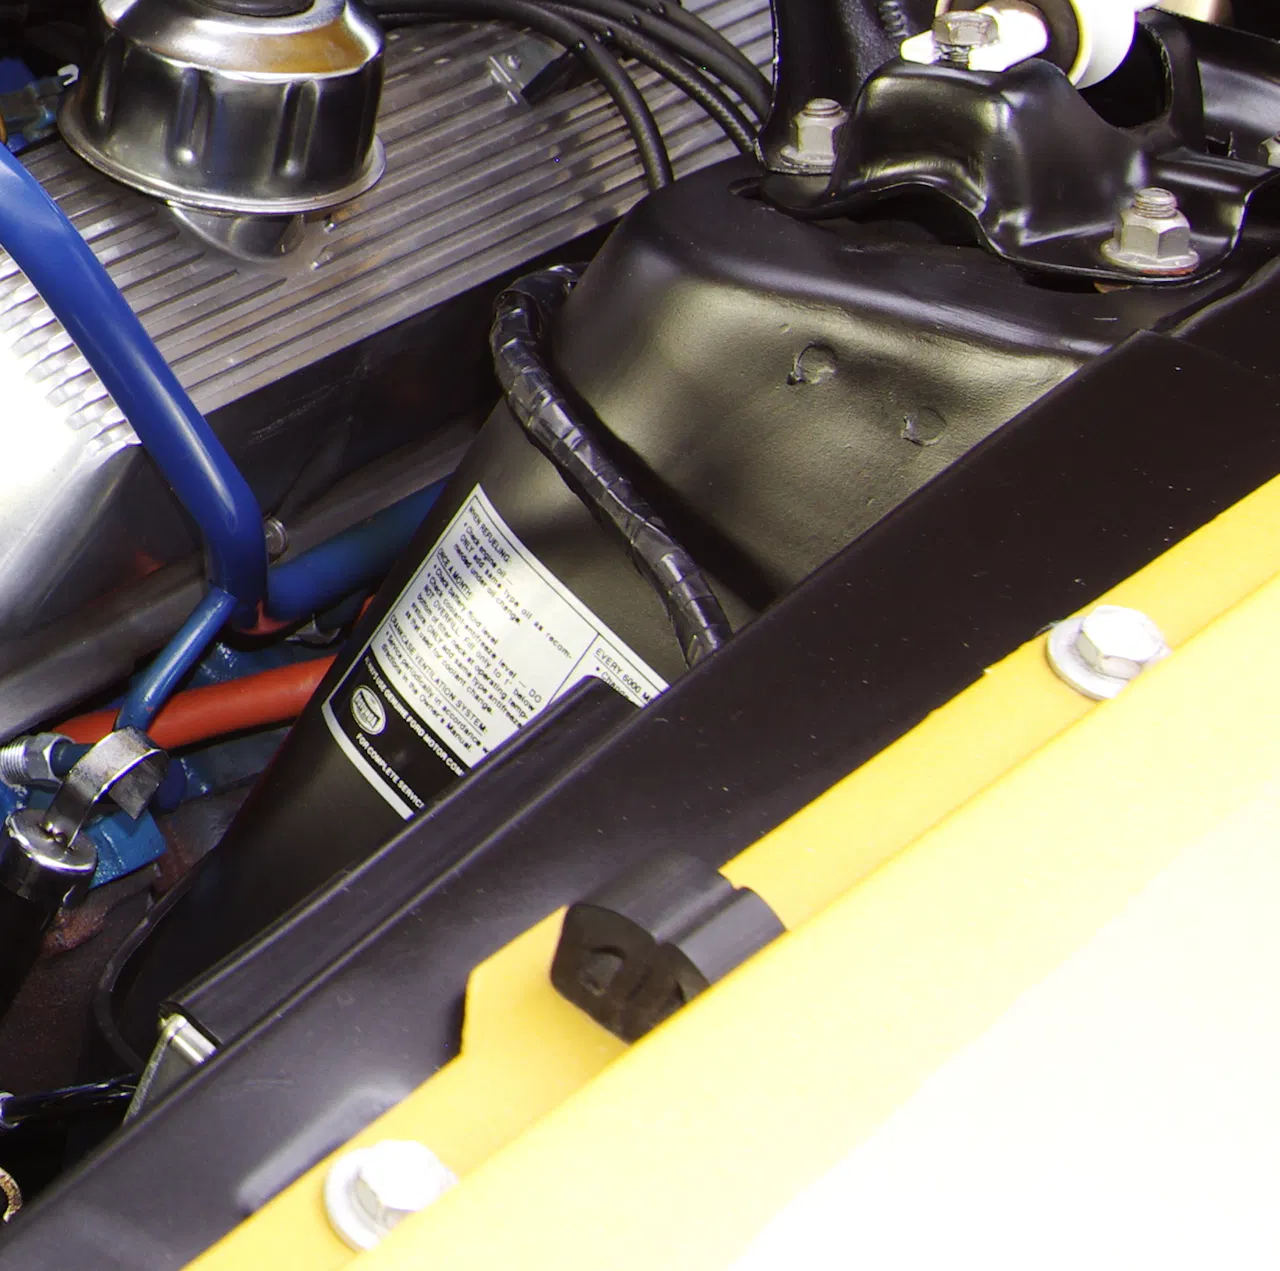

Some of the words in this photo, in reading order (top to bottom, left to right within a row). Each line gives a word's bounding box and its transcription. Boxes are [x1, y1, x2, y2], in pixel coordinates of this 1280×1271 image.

[470, 567, 487, 586] under
[487, 586, 496, 596] oil
[479, 546, 496, 568] engine
[497, 567, 506, 577] oil
[481, 626, 498, 644] level
[485, 569, 501, 588] same
[503, 589, 520, 607] type
[521, 608, 532, 618] oil
[533, 621, 543, 631] as
[545, 632, 572, 659] recom-
[408, 682, 419, 694] the
[414, 653, 456, 700] VENTILATION
[426, 624, 443, 644] ONLY
[442, 644, 454, 658] add
[454, 658, 472, 678] same
[471, 677, 488, 694] type
[488, 694, 523, 729] antifreeze
[431, 647, 442, 659] for
[442, 659, 466, 685] coolant
[451, 639, 467, 656] neck
[474, 664, 507, 699] operating
[507, 698, 528, 720] temp-
[475, 650, 491, 668] only
[492, 668, 502, 678] to
[512, 688, 534, 711] below
[498, 659, 517, 678] level
[528, 688, 542, 703] DO
[595, 647, 622, 674] EVERY
[621, 673, 642, 693] 6000
[601, 671, 629, 698] Chan
[382, 688, 410, 719] GENUINE
[405, 715, 426, 737] FORD
[422, 733, 449, 760] MOTOR
[400, 658, 435, 697] periodically
[442, 705, 481, 746] accordance
[355, 732, 370, 749] FOR
[366, 745, 400, 784] COMPLETE
